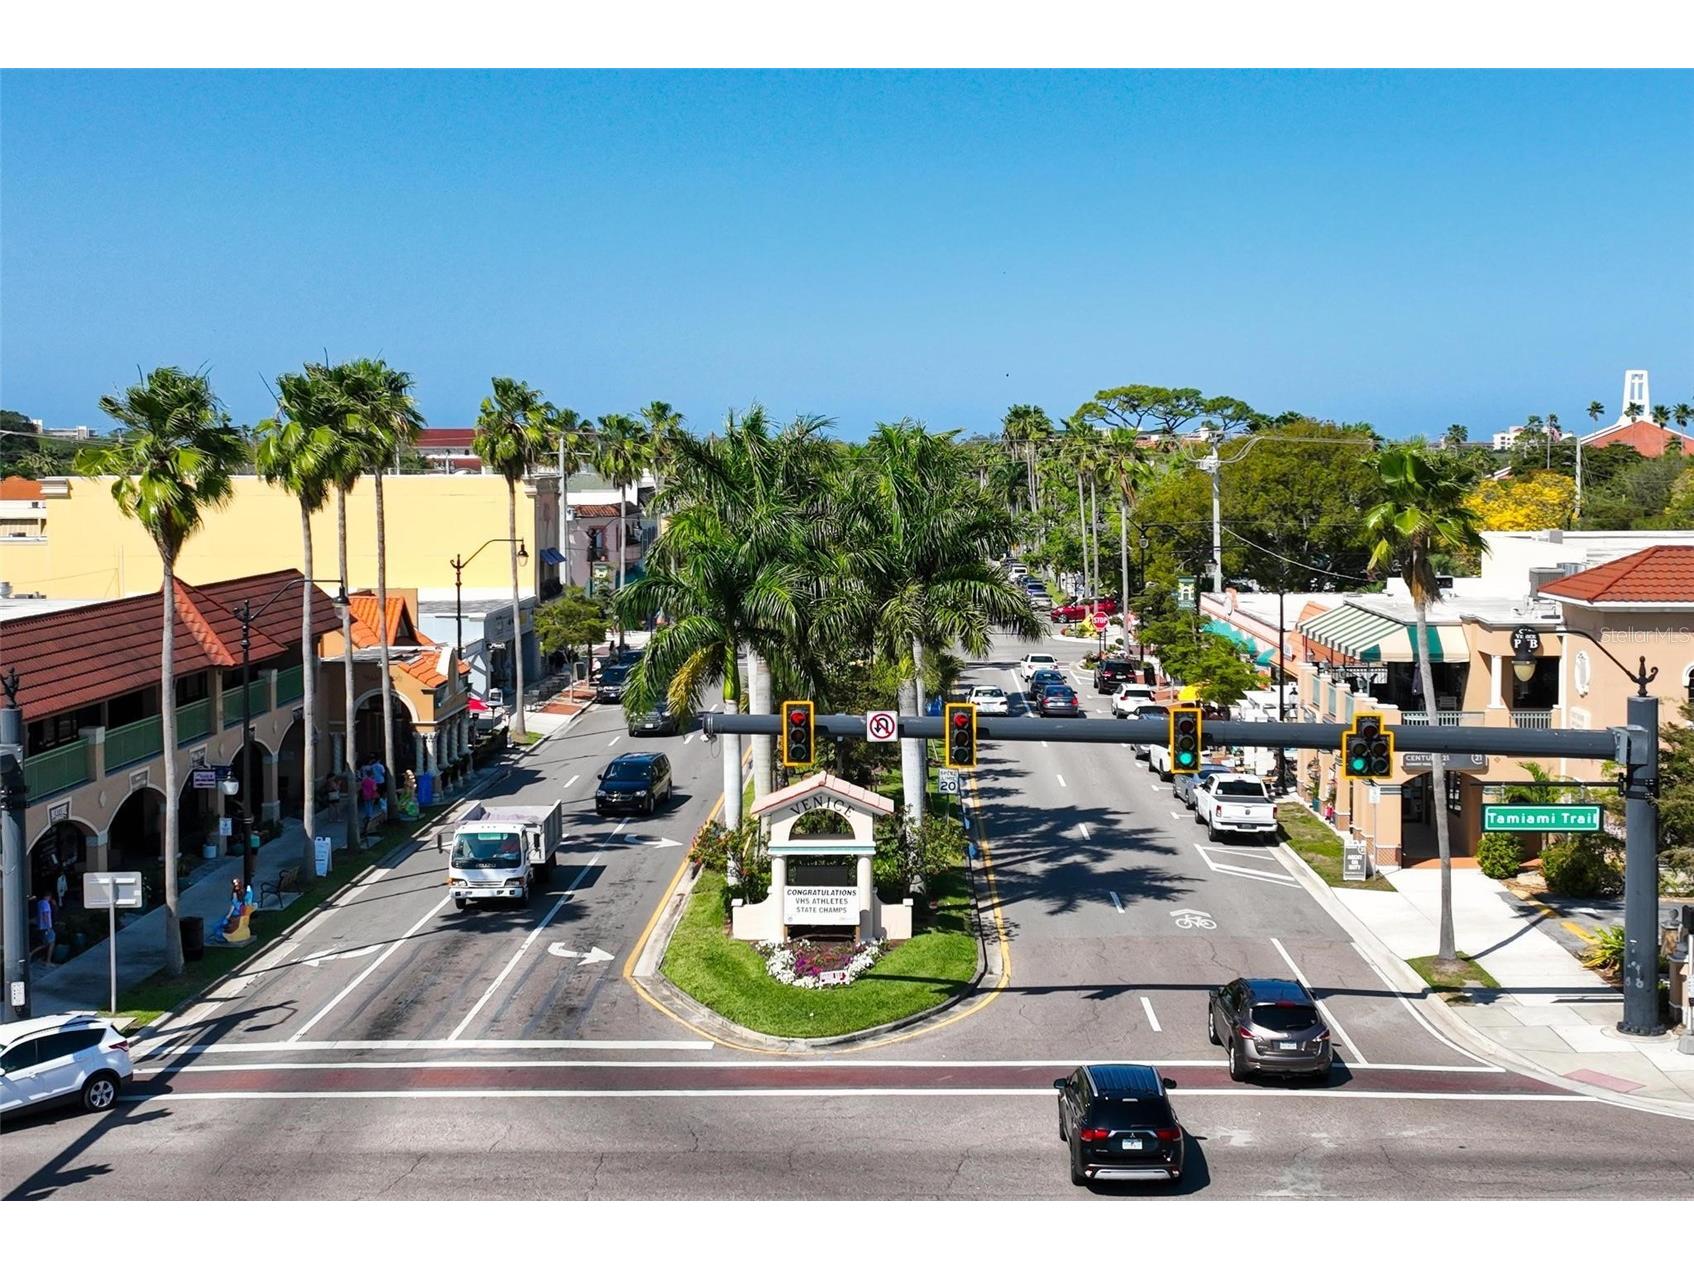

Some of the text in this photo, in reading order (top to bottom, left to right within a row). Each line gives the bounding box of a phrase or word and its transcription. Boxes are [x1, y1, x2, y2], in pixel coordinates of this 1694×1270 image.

[1513, 639, 1539, 649] PB
[940, 781, 956, 791] 20
[790, 795, 856, 818] VENICE
[1487, 812, 1598, 824] Tamiami Trail
[786, 889, 857, 897] CONGRATULATIONS
[795, 897, 849, 905] VHS ATHLETES
[818, 906, 848, 914] CHAMPS
